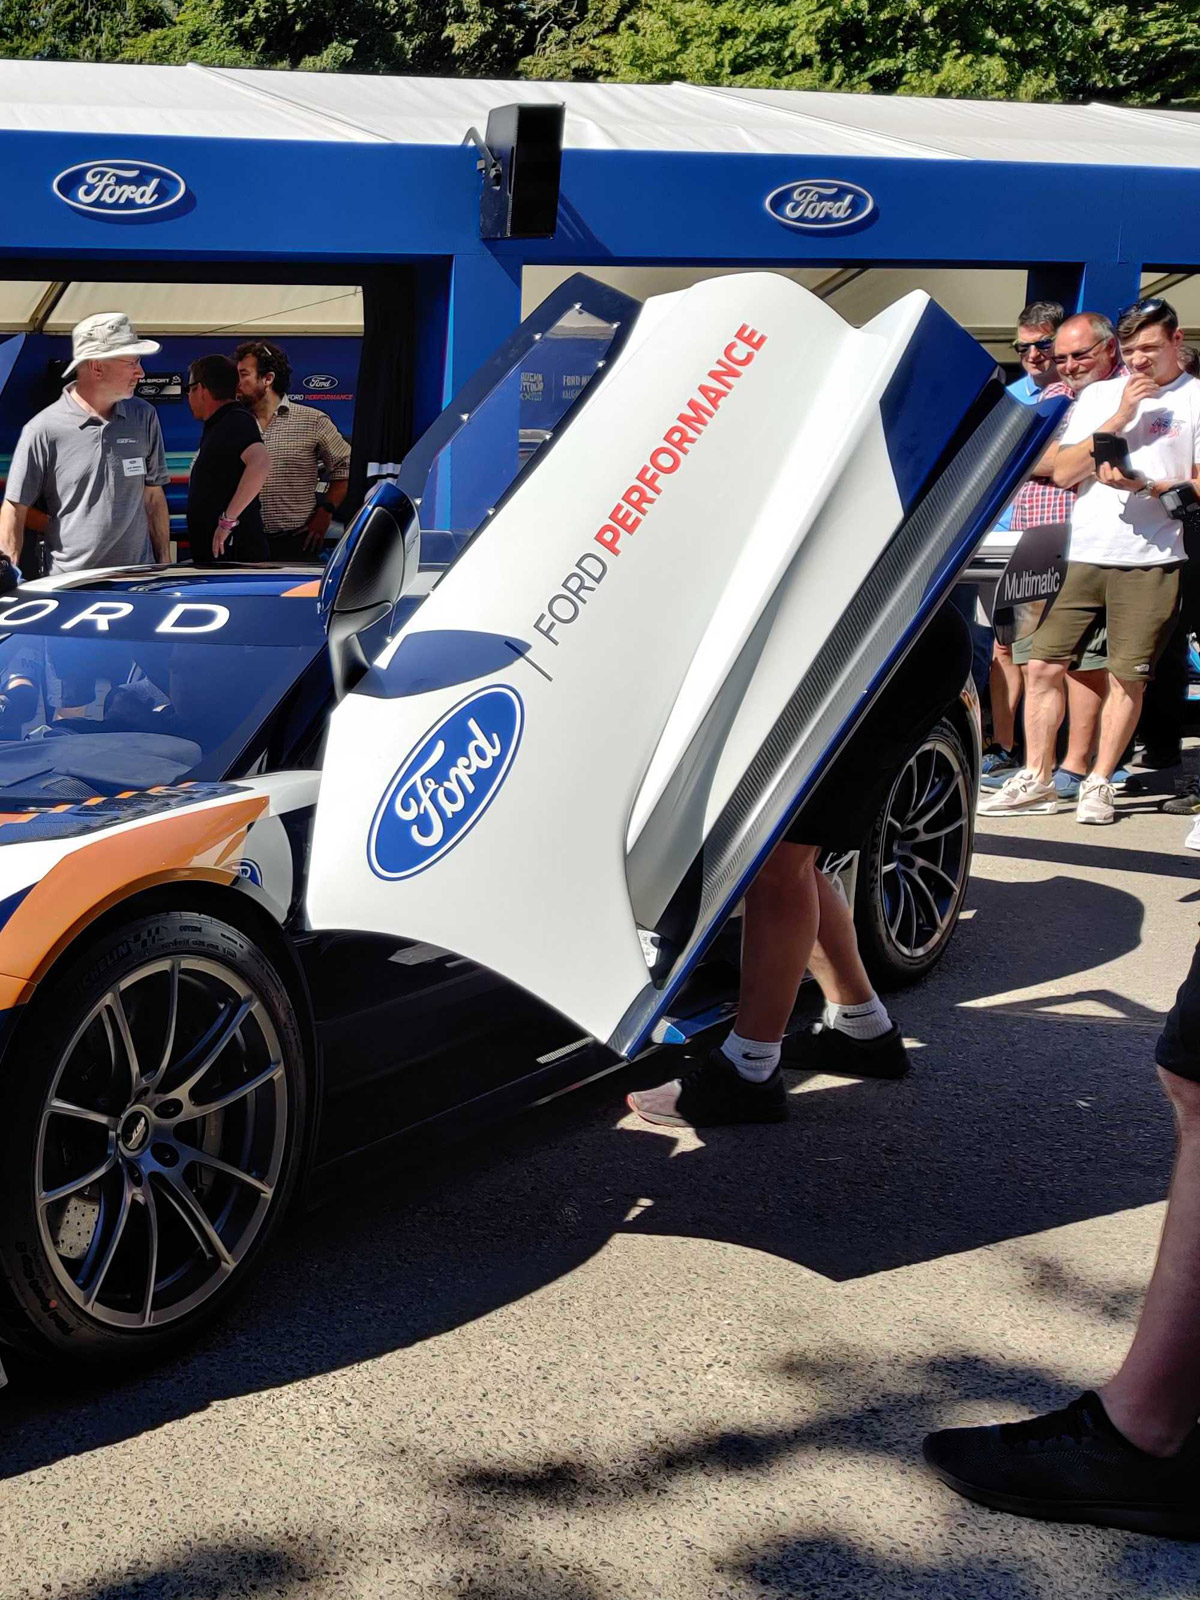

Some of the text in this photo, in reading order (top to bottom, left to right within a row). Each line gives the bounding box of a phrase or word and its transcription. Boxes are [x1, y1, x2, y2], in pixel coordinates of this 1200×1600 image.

[78, 166, 161, 205] Ford
[785, 185, 855, 219] Ford
[309, 377, 332, 388] Ford
[533, 322, 769, 647] FORD PERFORMANCE
[1004, 566, 1061, 601] Multimatic
[395, 717, 501, 847] Ford
